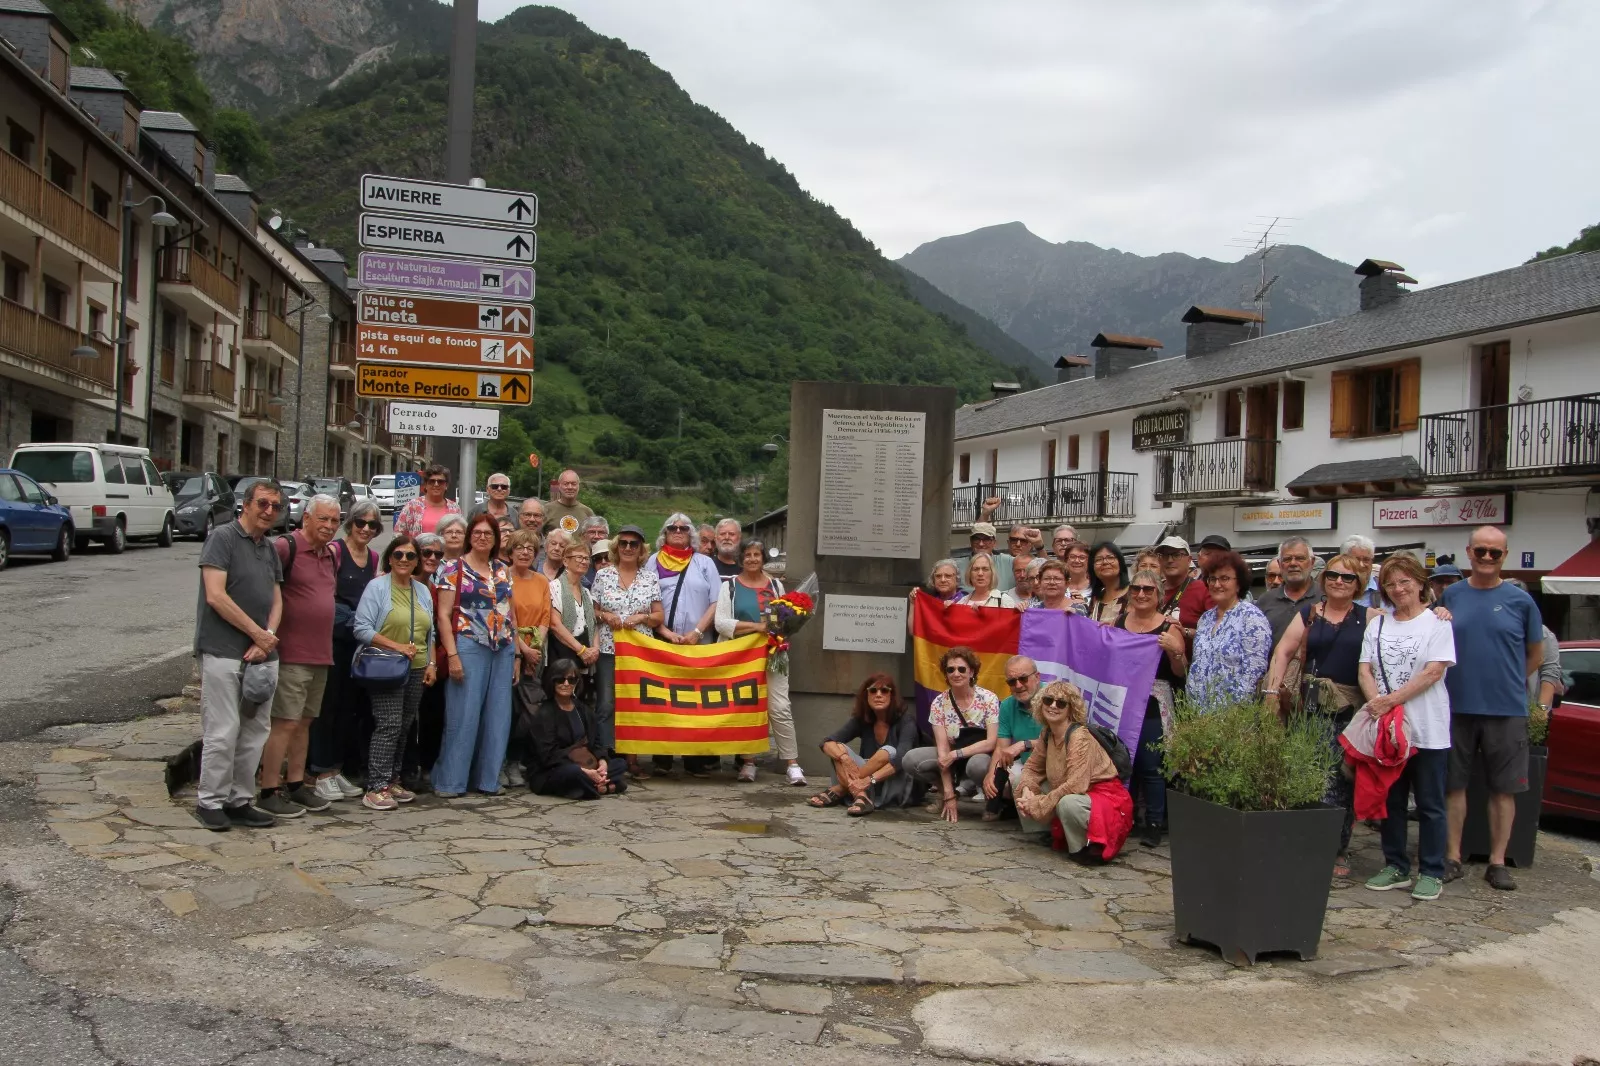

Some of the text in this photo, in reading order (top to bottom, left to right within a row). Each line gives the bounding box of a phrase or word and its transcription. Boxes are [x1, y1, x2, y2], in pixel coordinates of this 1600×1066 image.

[368, 186, 442, 206] JAVIERRE
[366, 224, 445, 244] ESPIERBA
[366, 259, 446, 274] Arte y Naturaleza
[366, 272, 410, 283] Escultura
[437, 278, 477, 289] Armajani
[364, 296, 414, 309] Valle de
[364, 307, 418, 324] Pineta
[360, 330, 478, 347] pista esquí de fondo
[360, 343, 398, 355] 14 Km
[362, 368, 408, 378] parador
[362, 379, 470, 397] Monte Perdido
[485, 385, 493, 396] P
[392, 407, 437, 419] Cerrado
[399, 421, 435, 432] hasta
[1134, 413, 1184, 436] HABITACIONES
[1278, 509, 1323, 519] RESTAURANTE
[1379, 498, 1498, 521] Pizzería La Vita
[1525, 553, 1531, 563] R
[639, 676, 759, 709] CCOO
